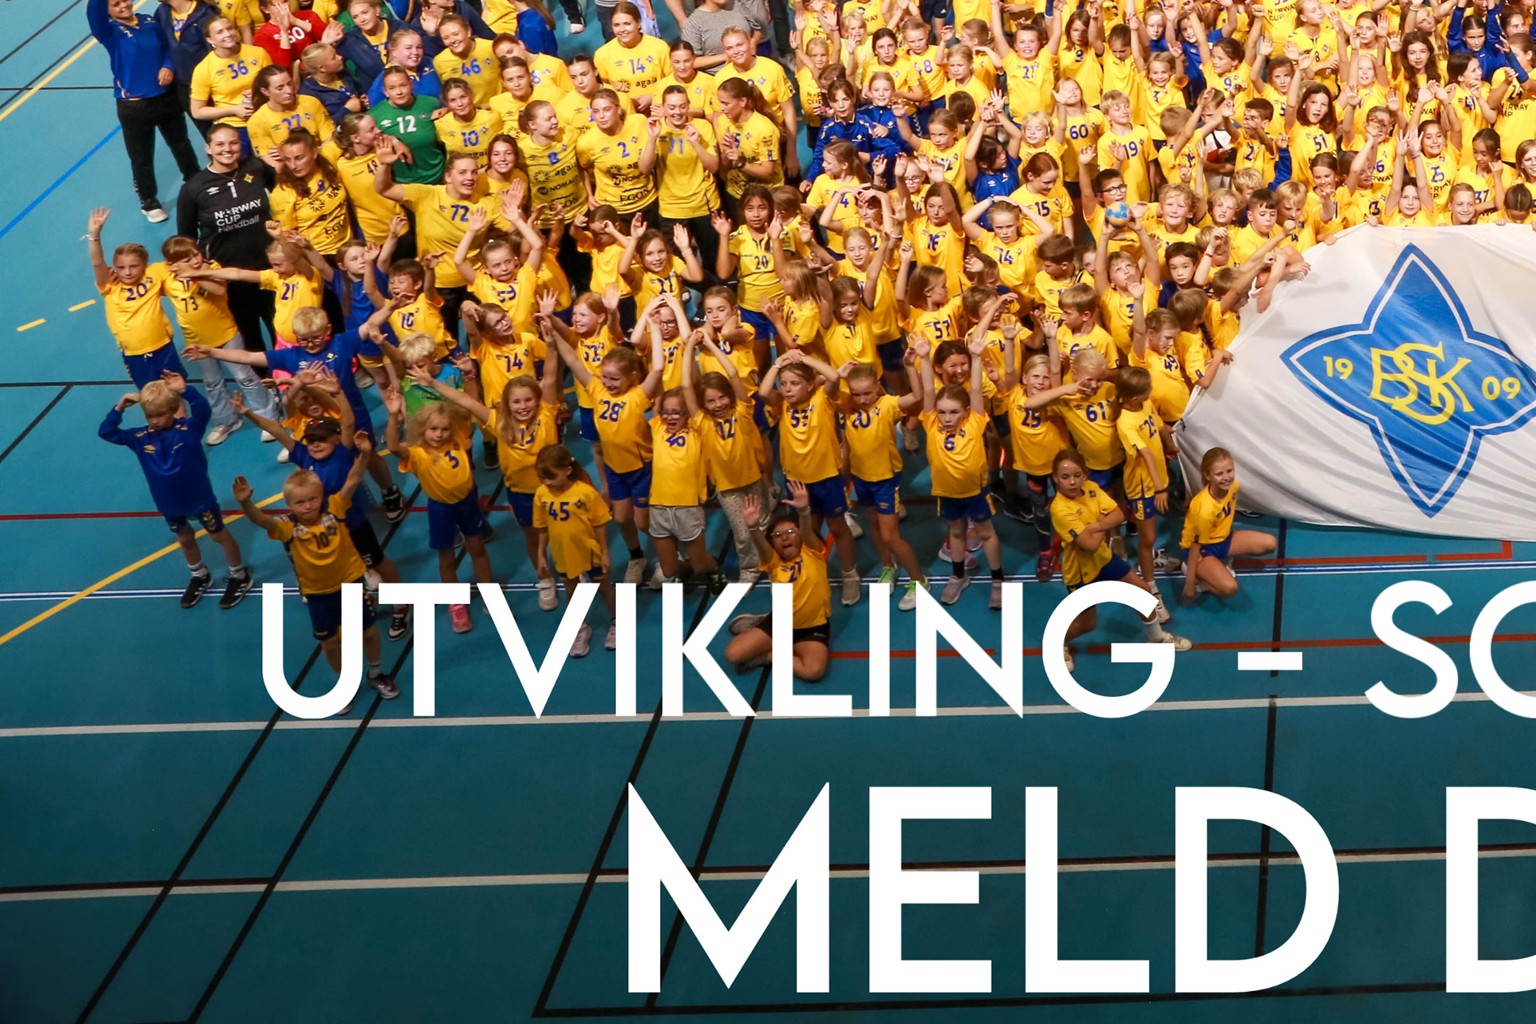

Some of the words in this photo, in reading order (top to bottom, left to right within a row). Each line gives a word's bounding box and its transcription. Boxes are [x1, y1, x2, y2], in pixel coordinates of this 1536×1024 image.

[228, 63, 248, 78] 36
[461, 61, 482, 76] 46
[629, 59, 646, 73] 14
[397, 116, 416, 133] 12
[1069, 125, 1089, 139] 60
[460, 131, 479, 147] 10
[1313, 134, 1327, 152] 51
[618, 142, 630, 158] 2
[1244, 145, 1255, 161] 2
[228, 181, 238, 198] 1
[450, 204, 470, 222] 72
[1034, 201, 1051, 217] 15
[215, 214, 241, 227] CUP
[218, 214, 260, 233] Handball
[755, 256, 769, 270] 20
[125, 283, 148, 302] 20
[504, 354, 524, 373] 14
[1323, 355, 1353, 380] 19
[1369, 341, 1474, 425] BSK
[1481, 375, 1521, 400] 09
[599, 400, 620, 421] 28
[1086, 403, 1107, 422] 61
[851, 411, 871, 429] 20
[944, 434, 956, 452] 6
[447, 449, 461, 470] 3
[548, 502, 571, 521] 45
